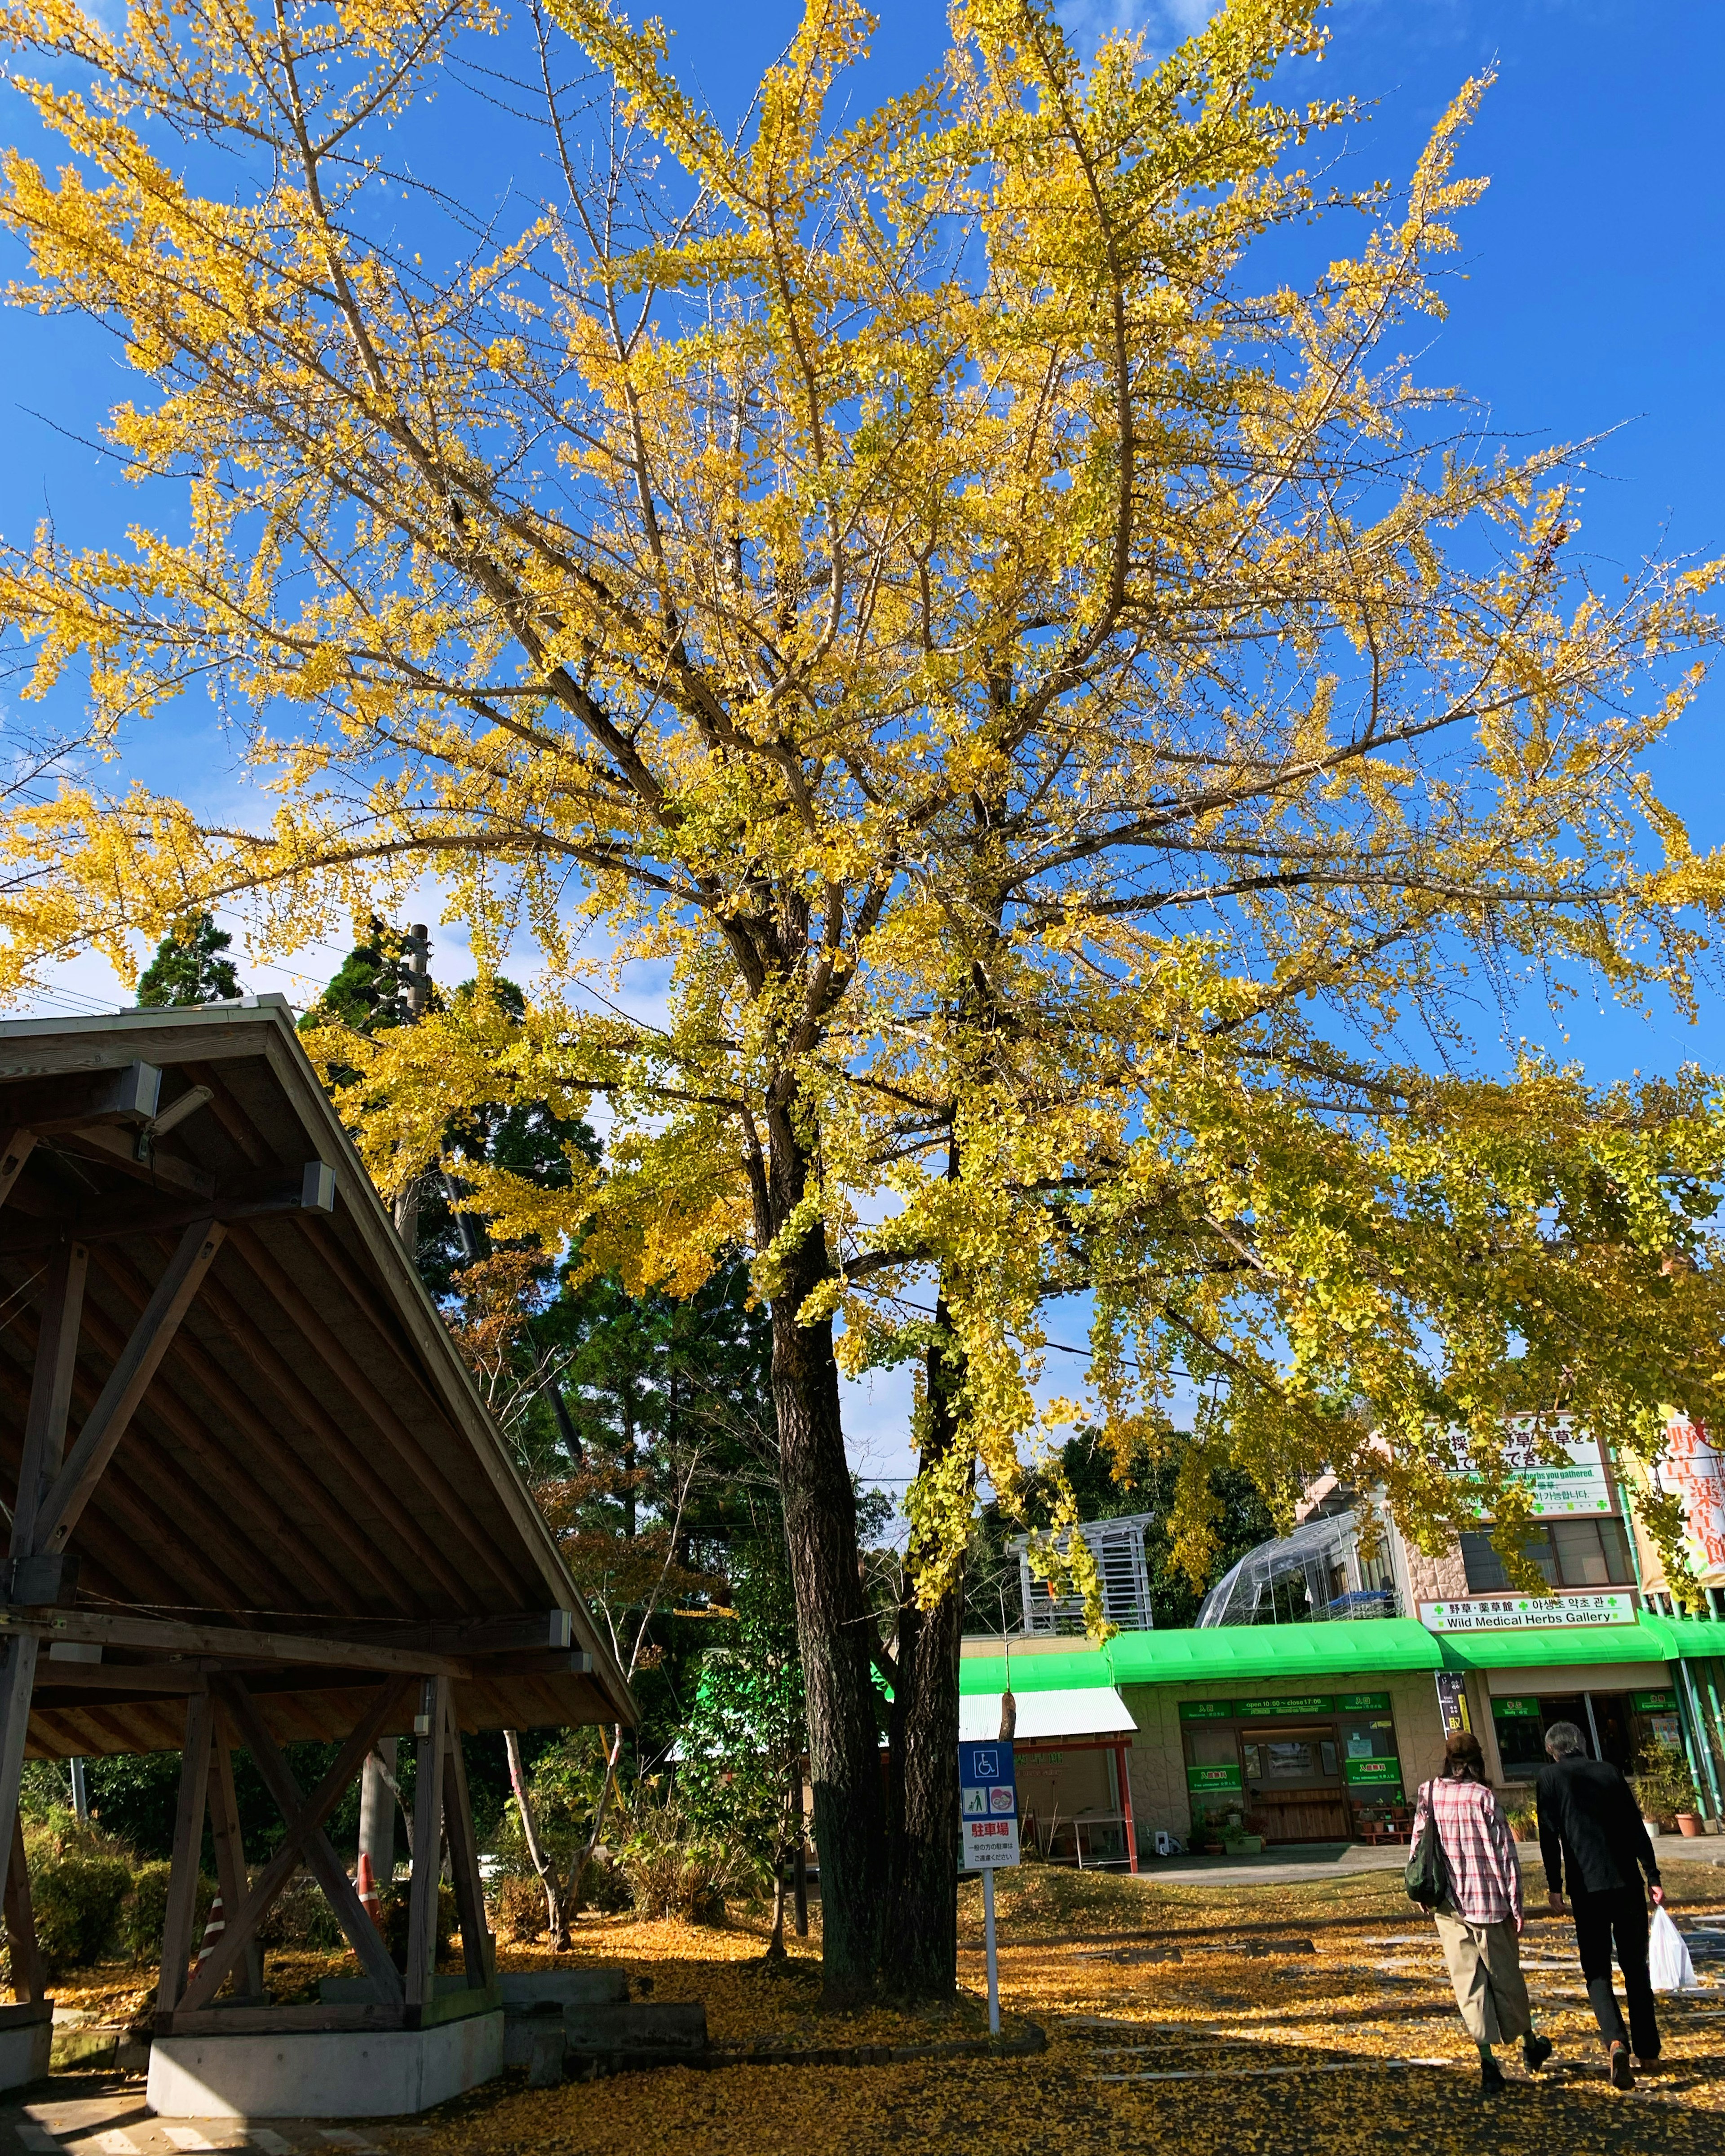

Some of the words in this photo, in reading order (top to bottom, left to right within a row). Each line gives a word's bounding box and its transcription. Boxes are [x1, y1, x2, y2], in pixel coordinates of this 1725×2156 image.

[1546, 1472, 1559, 1480] you
[1560, 1469, 1595, 1479] gathered.
[1544, 1490, 1590, 1501] 가능합니다.
[1532, 1598, 1566, 1612] 야생초
[1568, 1597, 1591, 1609] 약초
[1593, 1596, 1604, 1608] 관
[1447, 1617, 1471, 1628] Wild
[1476, 1613, 1522, 1626] Medical
[1526, 1611, 1562, 1624] Herbs
[1566, 1609, 1610, 1622] Gallery
[972, 1822, 1009, 1837] 駐車場
[968, 1842, 1013, 1851] 一般の方の駐車は
[975, 1854, 1012, 1862] ご遠慮ください
